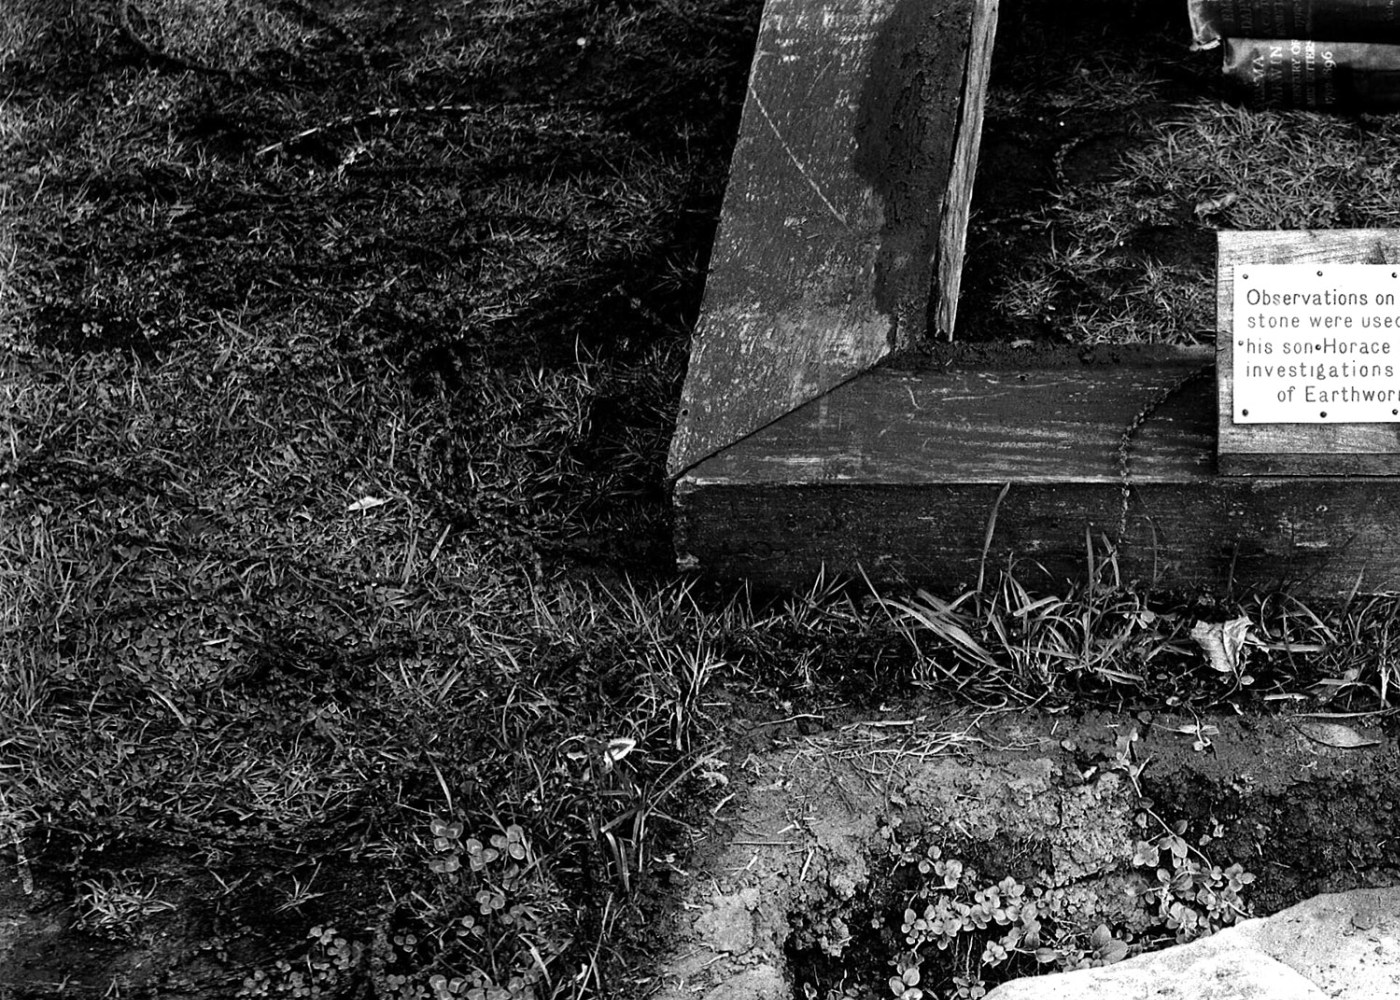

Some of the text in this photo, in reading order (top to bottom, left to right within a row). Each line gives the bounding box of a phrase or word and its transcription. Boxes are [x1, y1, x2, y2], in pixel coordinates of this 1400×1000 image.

[1246, 288, 1368, 306] Observations
[1375, 293, 1395, 306] on
[1247, 313, 1300, 329] stone
[1309, 316, 1353, 329] were
[1246, 337, 1273, 354] his
[1283, 343, 1313, 354] son
[1323, 337, 1391, 354] Horace
[1246, 361, 1394, 381] investigations
[1277, 384, 1295, 402] of
